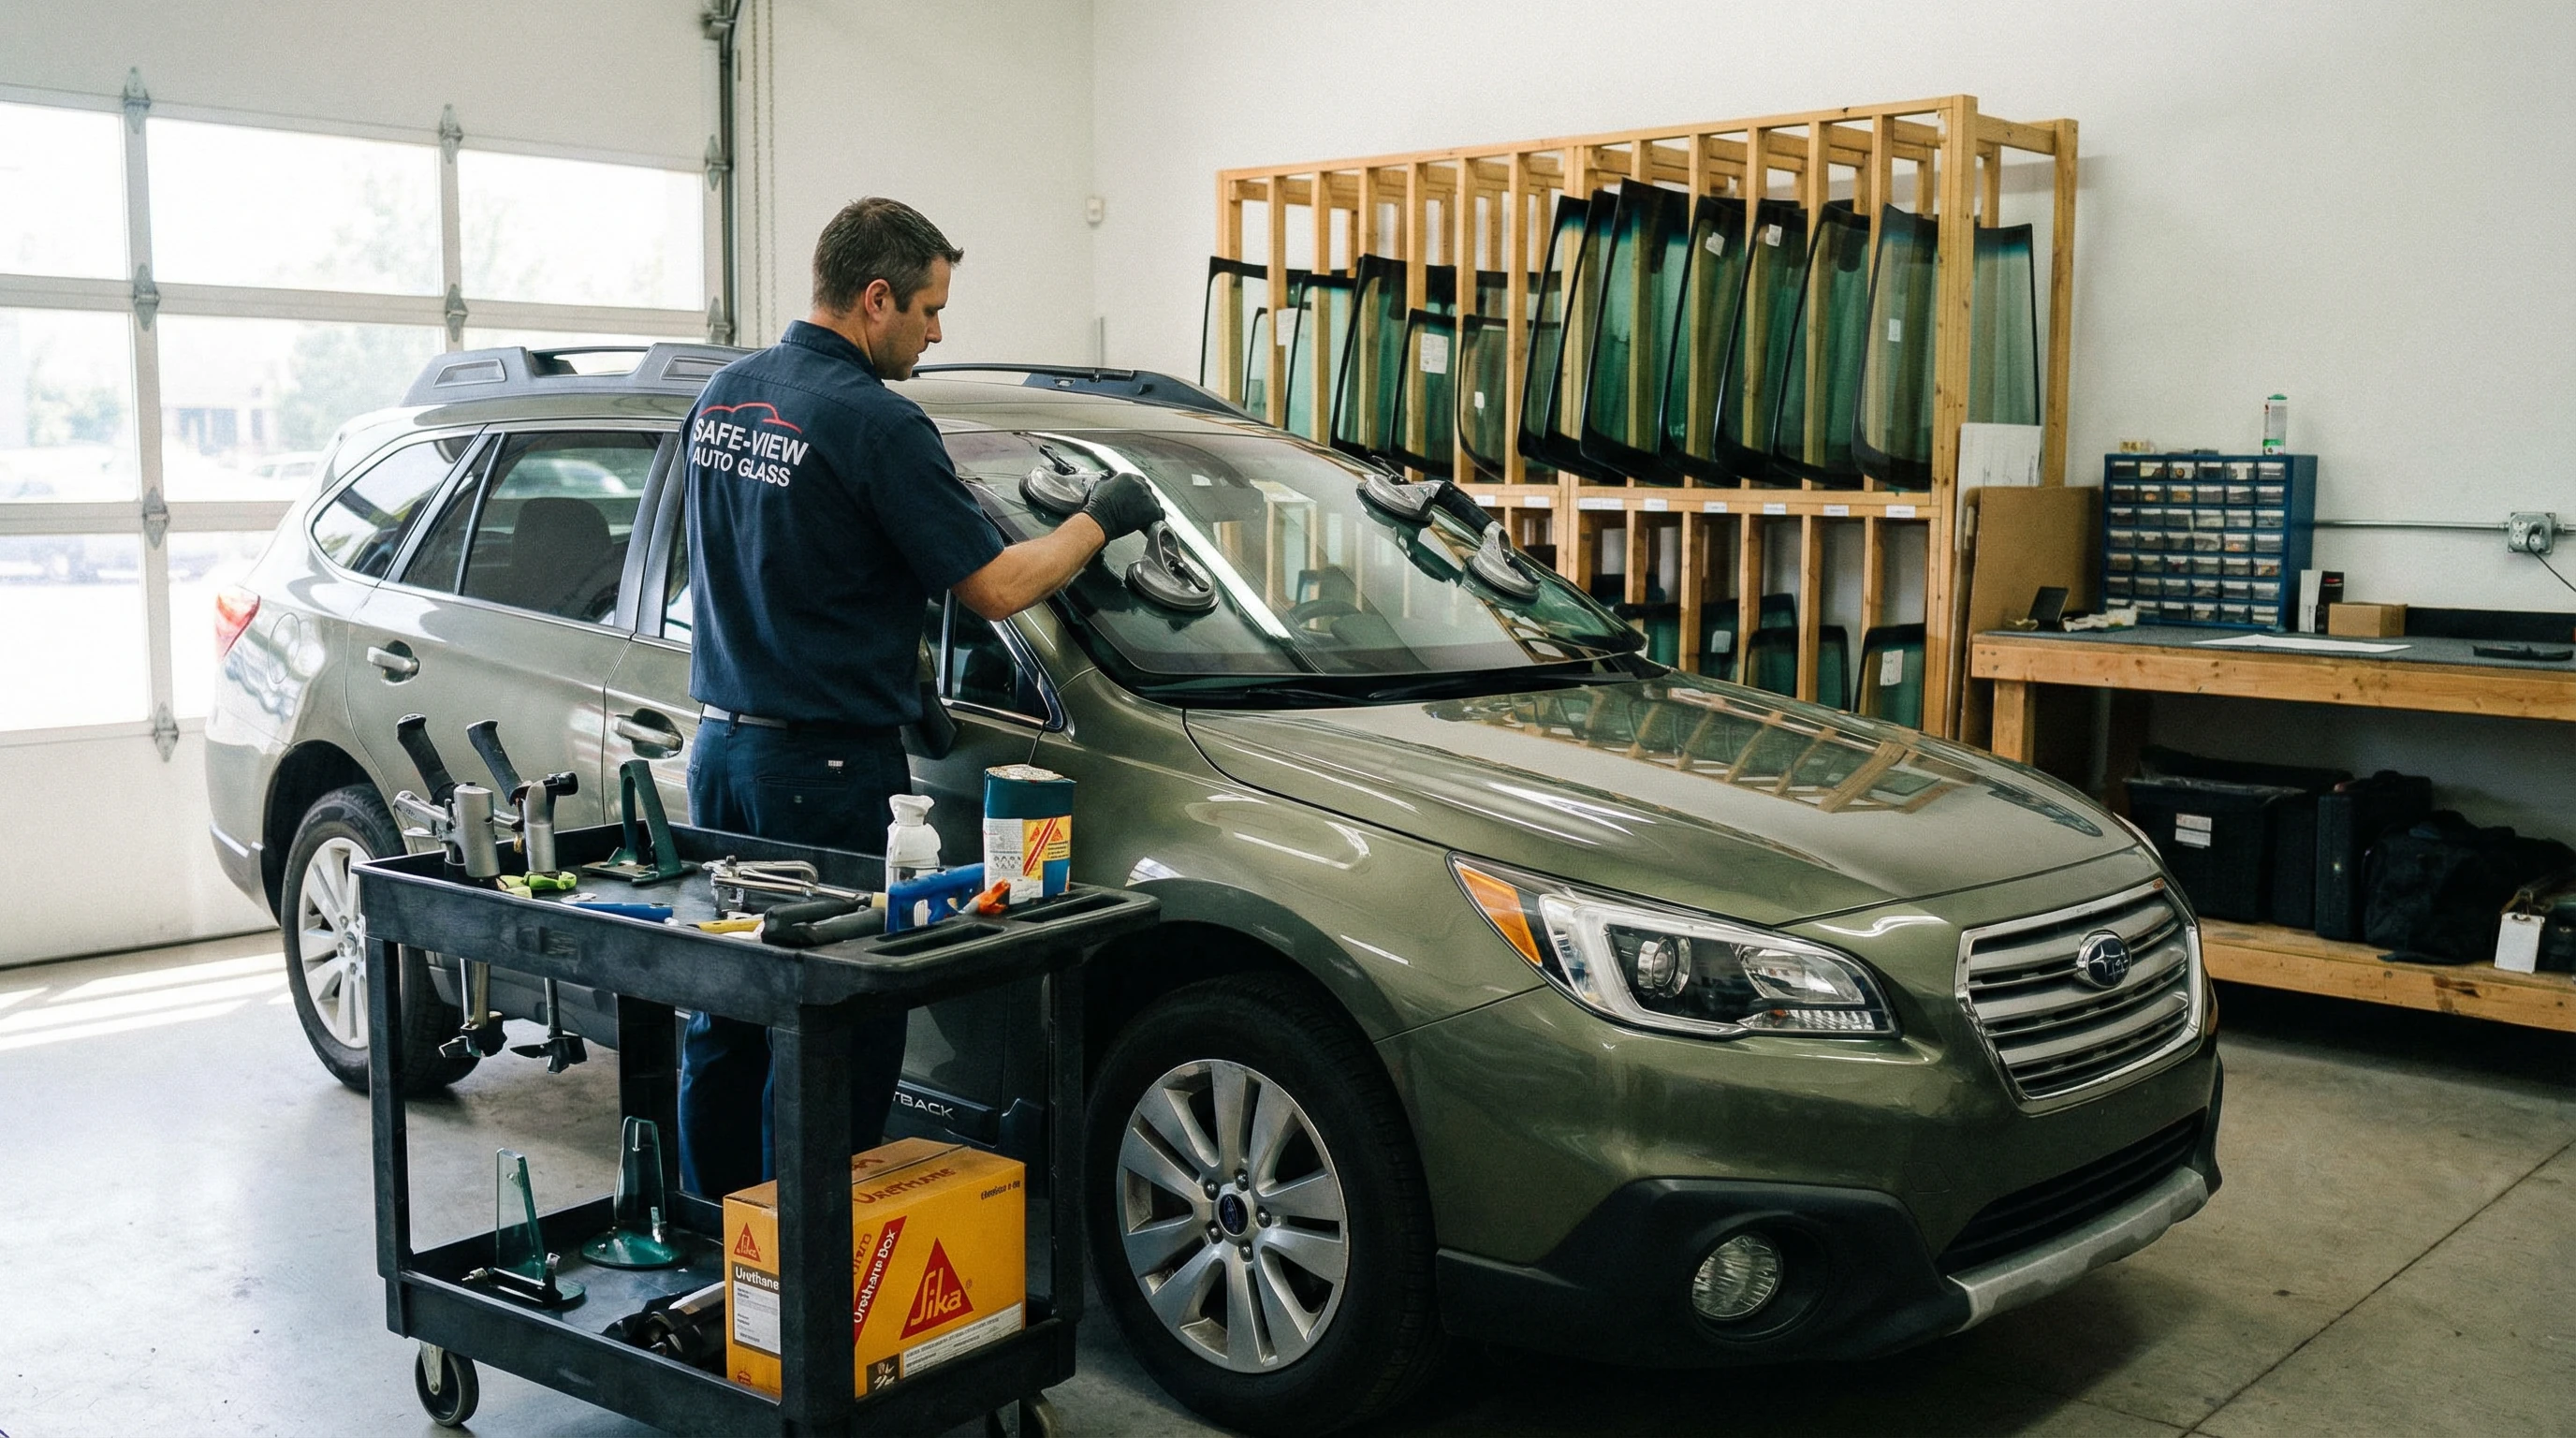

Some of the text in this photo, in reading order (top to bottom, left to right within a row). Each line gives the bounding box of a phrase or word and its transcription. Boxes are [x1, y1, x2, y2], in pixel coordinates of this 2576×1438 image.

[693, 418, 810, 466] SAFE-VIEW
[692, 446, 791, 487] AUTO GLASS
[910, 1267, 962, 1327] Sika
